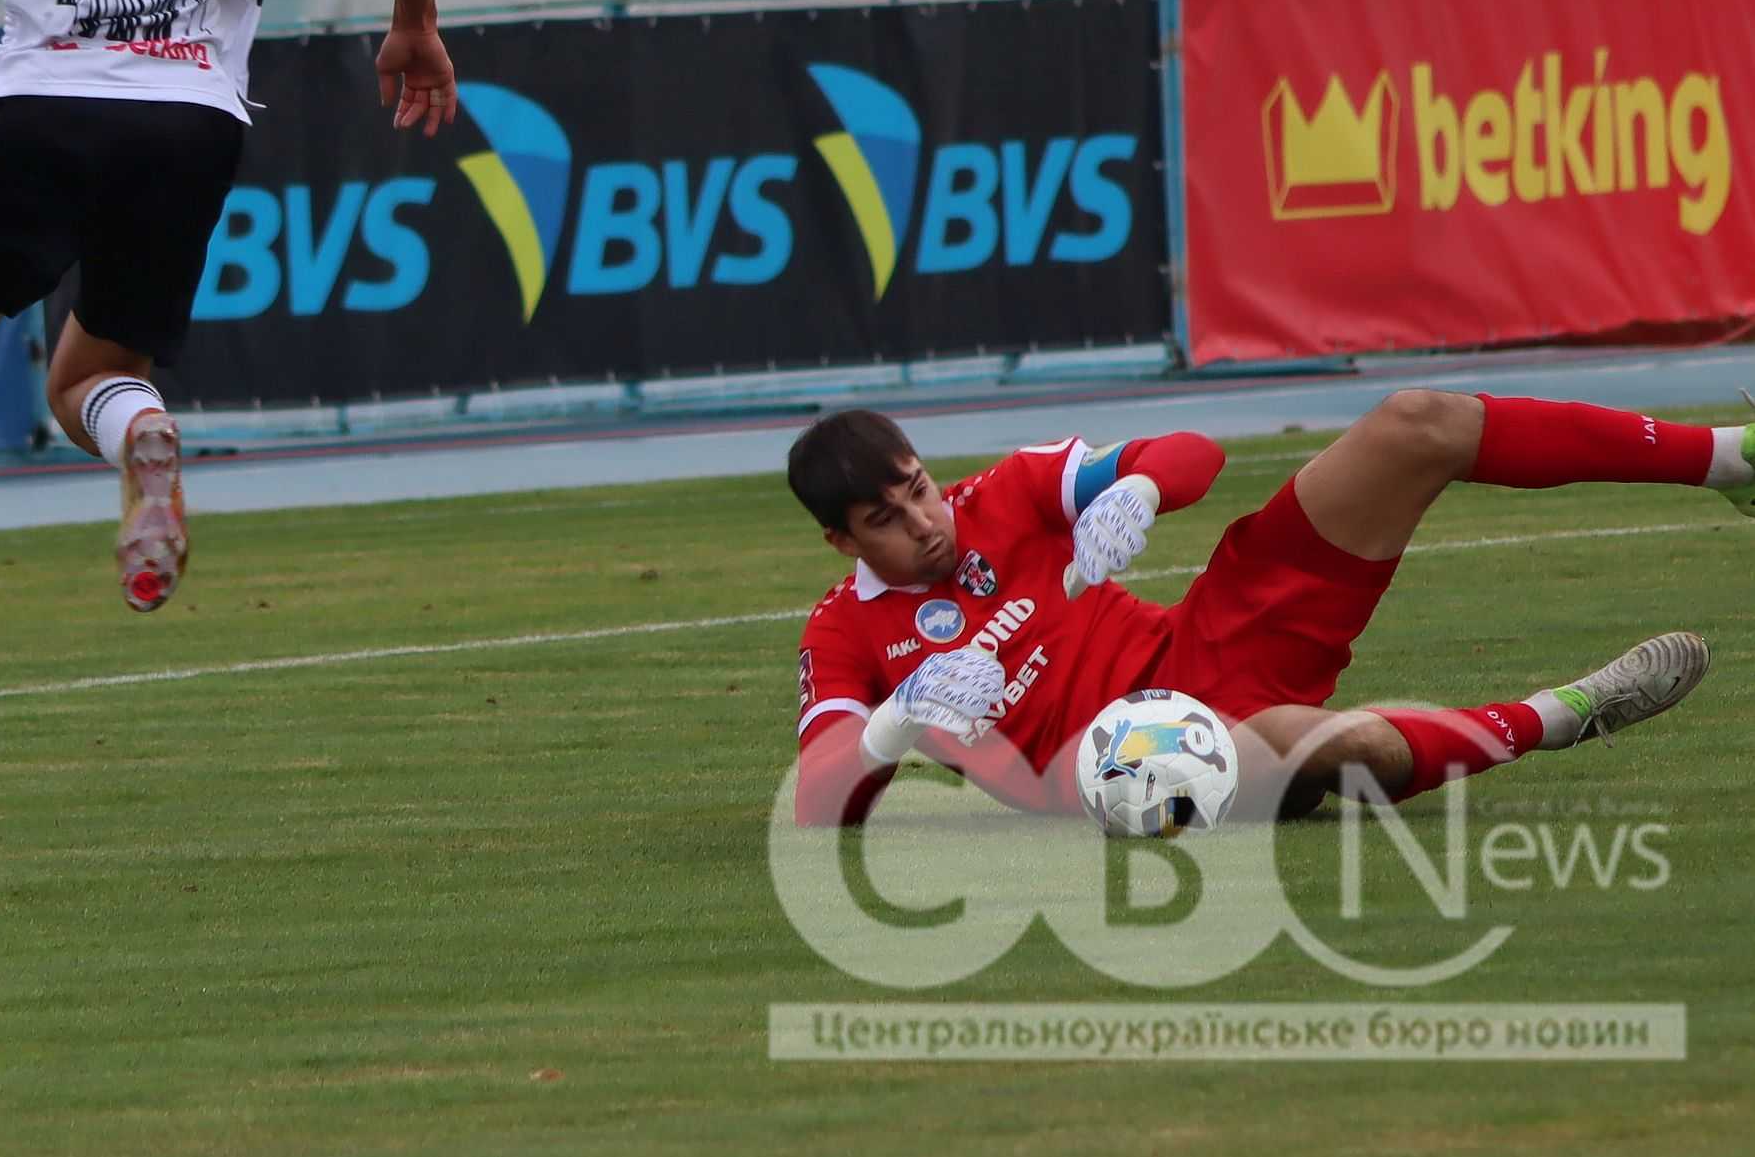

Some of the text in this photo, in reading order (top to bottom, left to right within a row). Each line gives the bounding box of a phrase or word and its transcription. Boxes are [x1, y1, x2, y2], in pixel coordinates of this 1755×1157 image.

[916, 134, 1138, 274] BVS
[1411, 47, 1732, 236] betking
[190, 177, 437, 320] BVS
[567, 154, 798, 294] BVS
